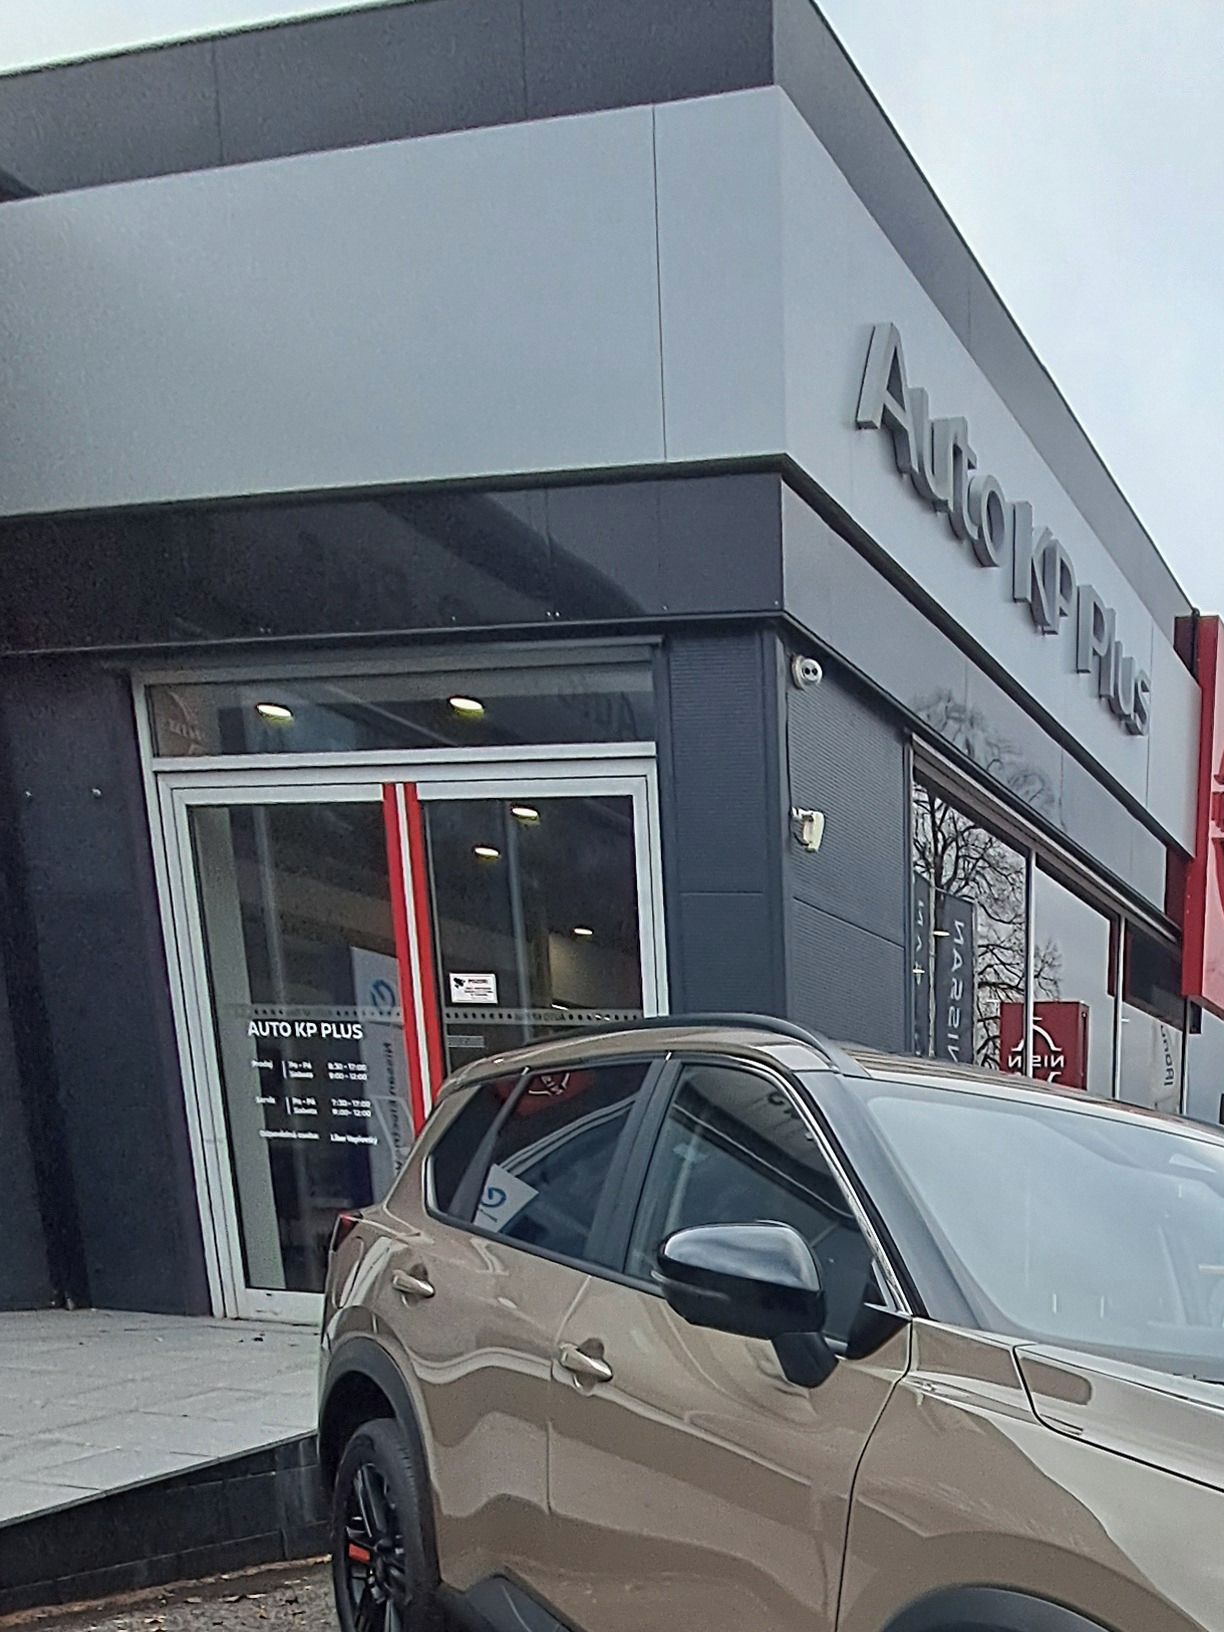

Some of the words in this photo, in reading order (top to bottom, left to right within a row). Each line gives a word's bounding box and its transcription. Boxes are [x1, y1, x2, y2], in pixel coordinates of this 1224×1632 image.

[856, 322, 1006, 567] Auto
[1012, 500, 1078, 636] KP
[1076, 584, 1152, 736] Plus
[247, 1020, 292, 1037] AUTO
[295, 1022, 317, 1038] KP
[321, 1022, 364, 1040] PLUS
